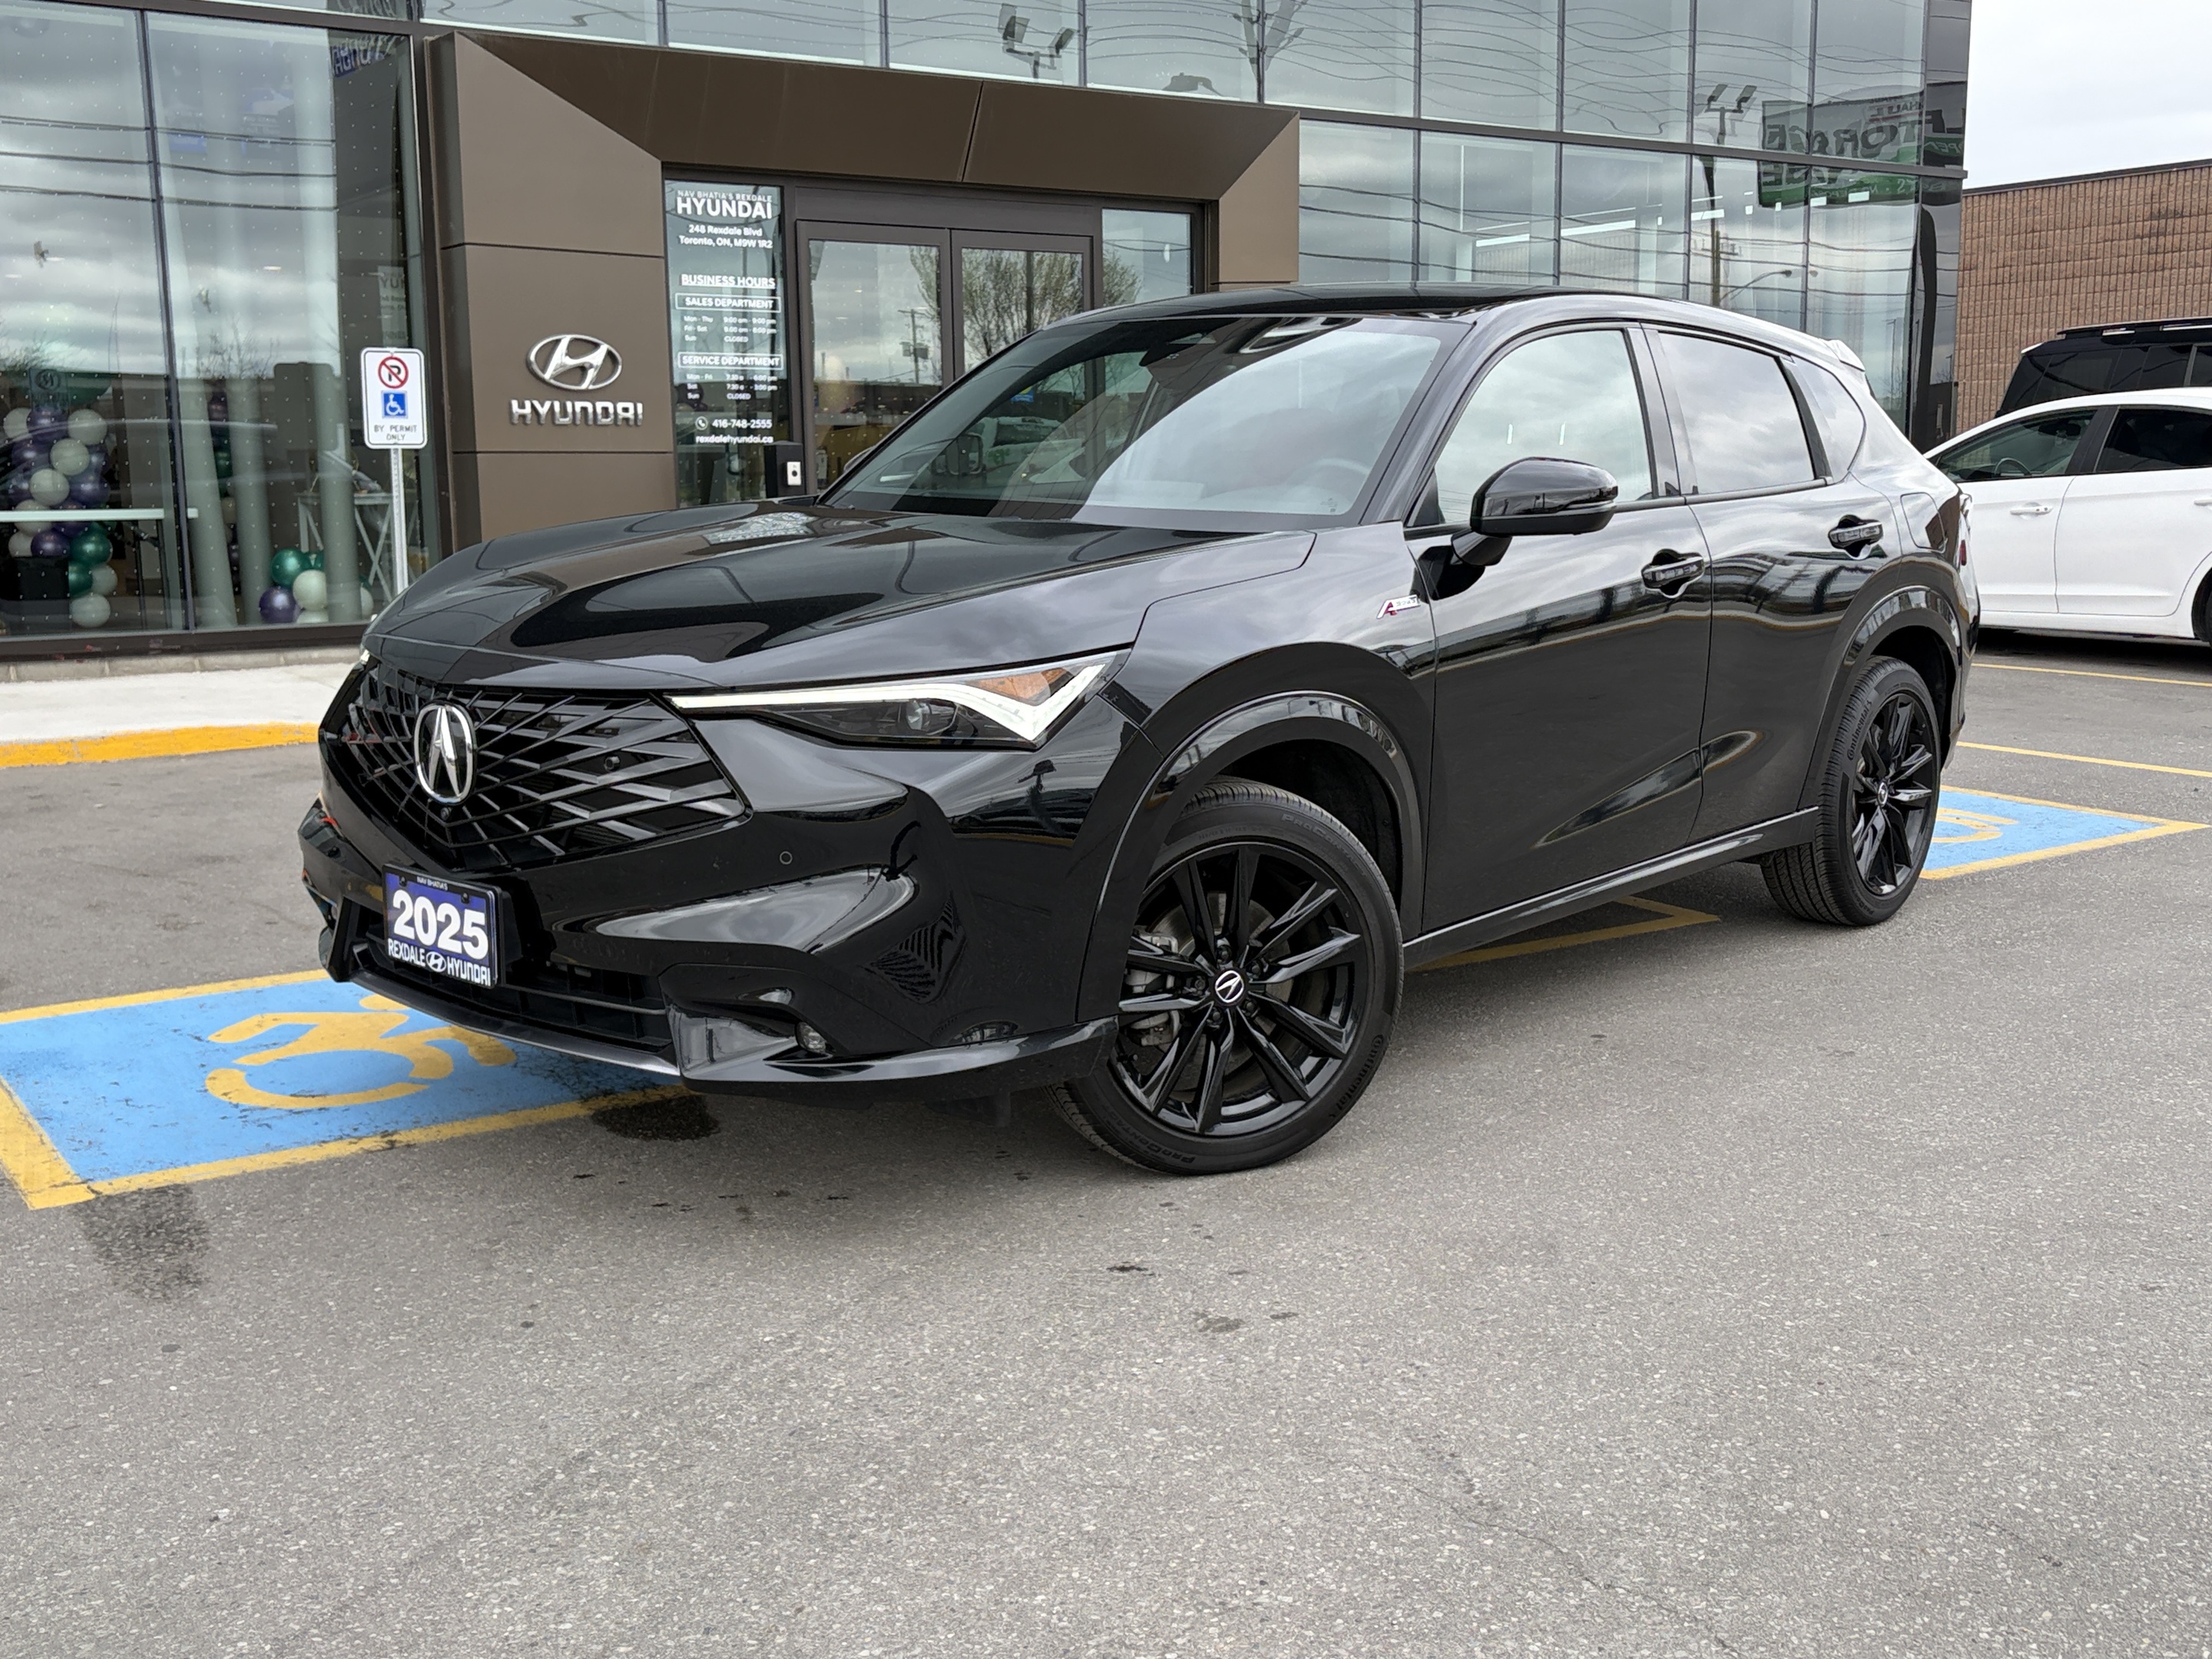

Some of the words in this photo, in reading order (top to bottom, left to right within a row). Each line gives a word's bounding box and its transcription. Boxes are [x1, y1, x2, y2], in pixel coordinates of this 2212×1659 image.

[735, 194, 773, 202] REXDALE
[677, 197, 772, 219] HYUNDAI
[707, 225, 741, 235] Rexdale
[743, 227, 763, 237] Blvd
[679, 235, 716, 247] Toronto,
[716, 237, 733, 247] ON,
[681, 273, 736, 286] BUSINESS
[737, 276, 776, 288] HOURS
[685, 297, 714, 306] SALES
[714, 298, 774, 309] DEPARTMENT
[682, 356, 720, 365] SERVICE
[720, 356, 780, 366] DEPARTMENT
[510, 399, 644, 426] HYUNDAI
[374, 425, 385, 433] BY
[389, 425, 418, 433] PERMIT
[695, 434, 774, 445] rexdalehyundai.ca
[392, 889, 489, 960] 2025
[387, 938, 426, 968] REXDALE
[446, 955, 492, 987] HYUNDAI
